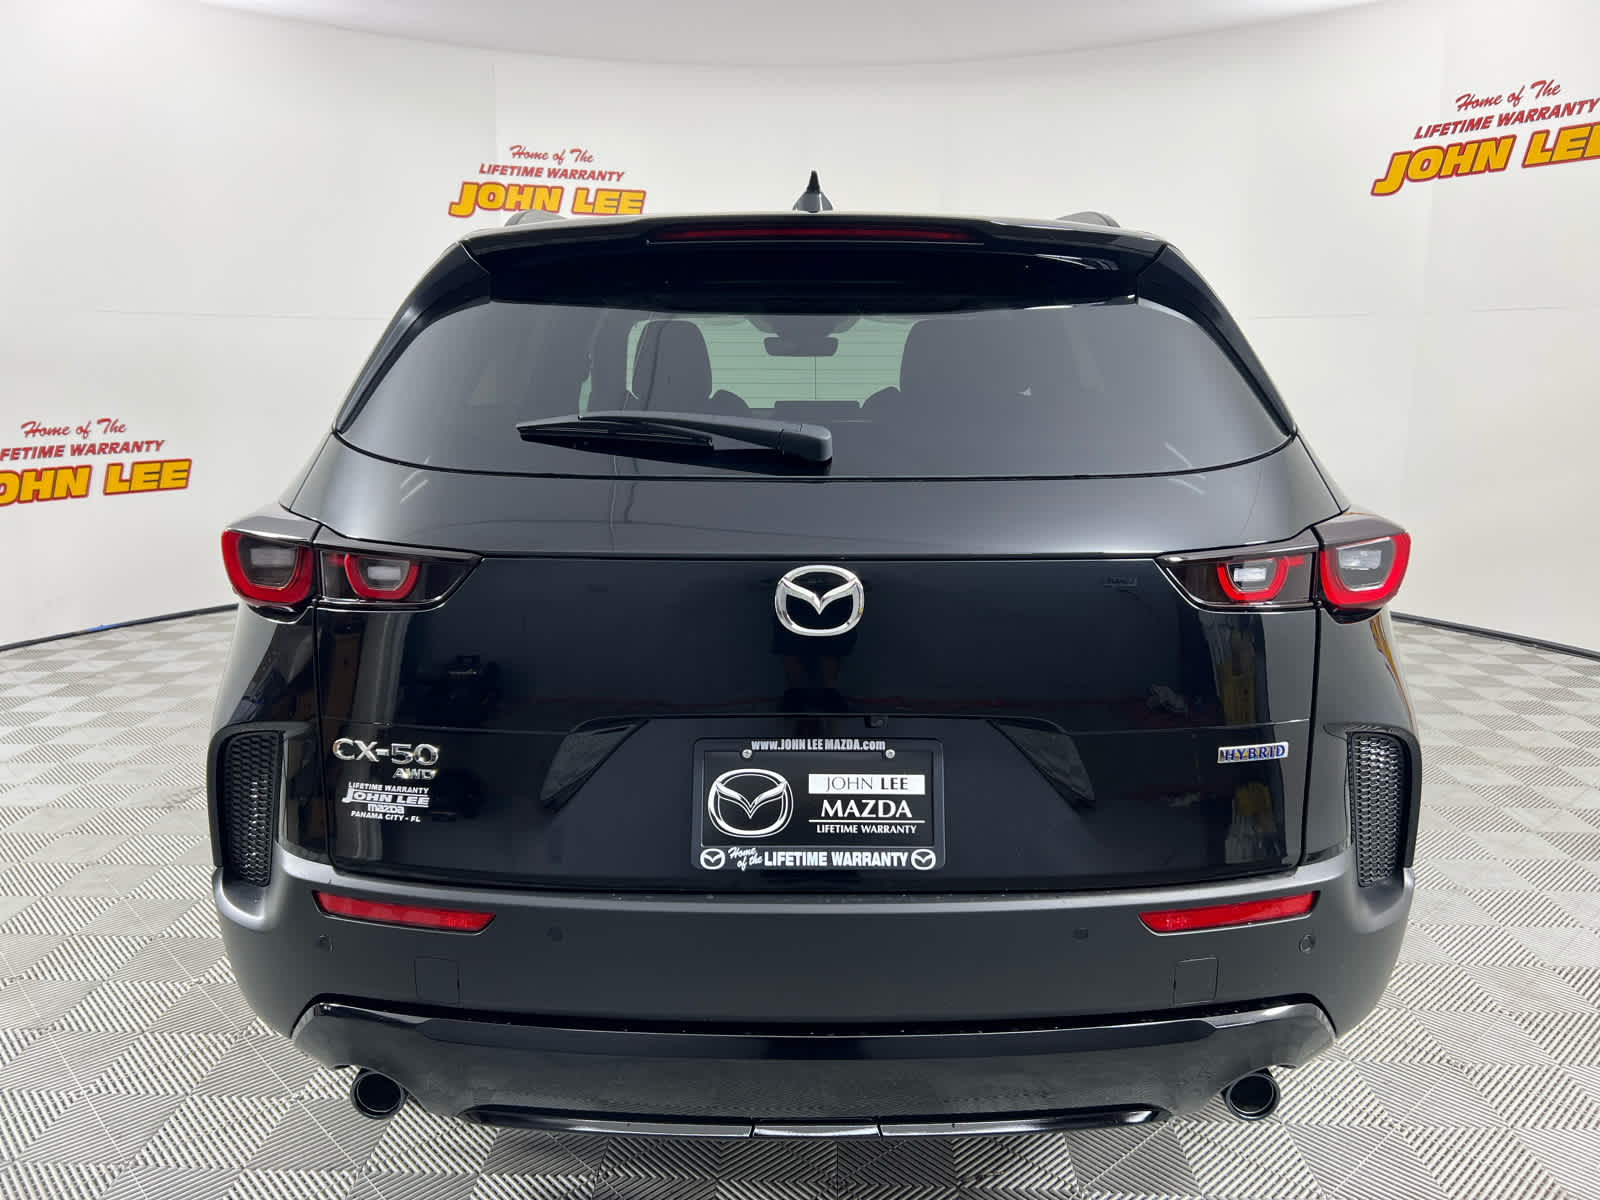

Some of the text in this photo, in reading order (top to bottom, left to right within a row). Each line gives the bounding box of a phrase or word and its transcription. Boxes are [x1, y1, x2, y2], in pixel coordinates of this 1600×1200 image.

[1455, 79, 1561, 112] Home of The
[1414, 97, 1600, 139] LIFETIME WARRANTY
[510, 145, 594, 165] Home of The
[1370, 121, 1600, 196] JOHN LE
[479, 163, 625, 182] LIFETIME WARRANTY
[448, 181, 647, 218] JOHN LEE
[21, 417, 127, 438] Home of The
[70, 440, 166, 457] WARRANTY
[103, 458, 192, 495] LEE
[333, 737, 440, 766] CX-50
[807, 739, 824, 750] LEE
[825, 738, 886, 750] MAZDA.com
[1224, 744, 1286, 761] HYBRID
[392, 767, 438, 780] AWD
[348, 781, 430, 794] LIFETIME WARRANTY
[825, 777, 909, 792] JOHN LEE
[342, 787, 430, 805] JOHN LEE
[350, 810, 383, 820] PANAMA
[820, 799, 913, 818] MAZDA
[816, 824, 917, 834] LIFETIME WARRANTY
[728, 846, 757, 859] Home
[764, 851, 909, 867] LIFETIME WARRANTY
[736, 853, 763, 872] of the
